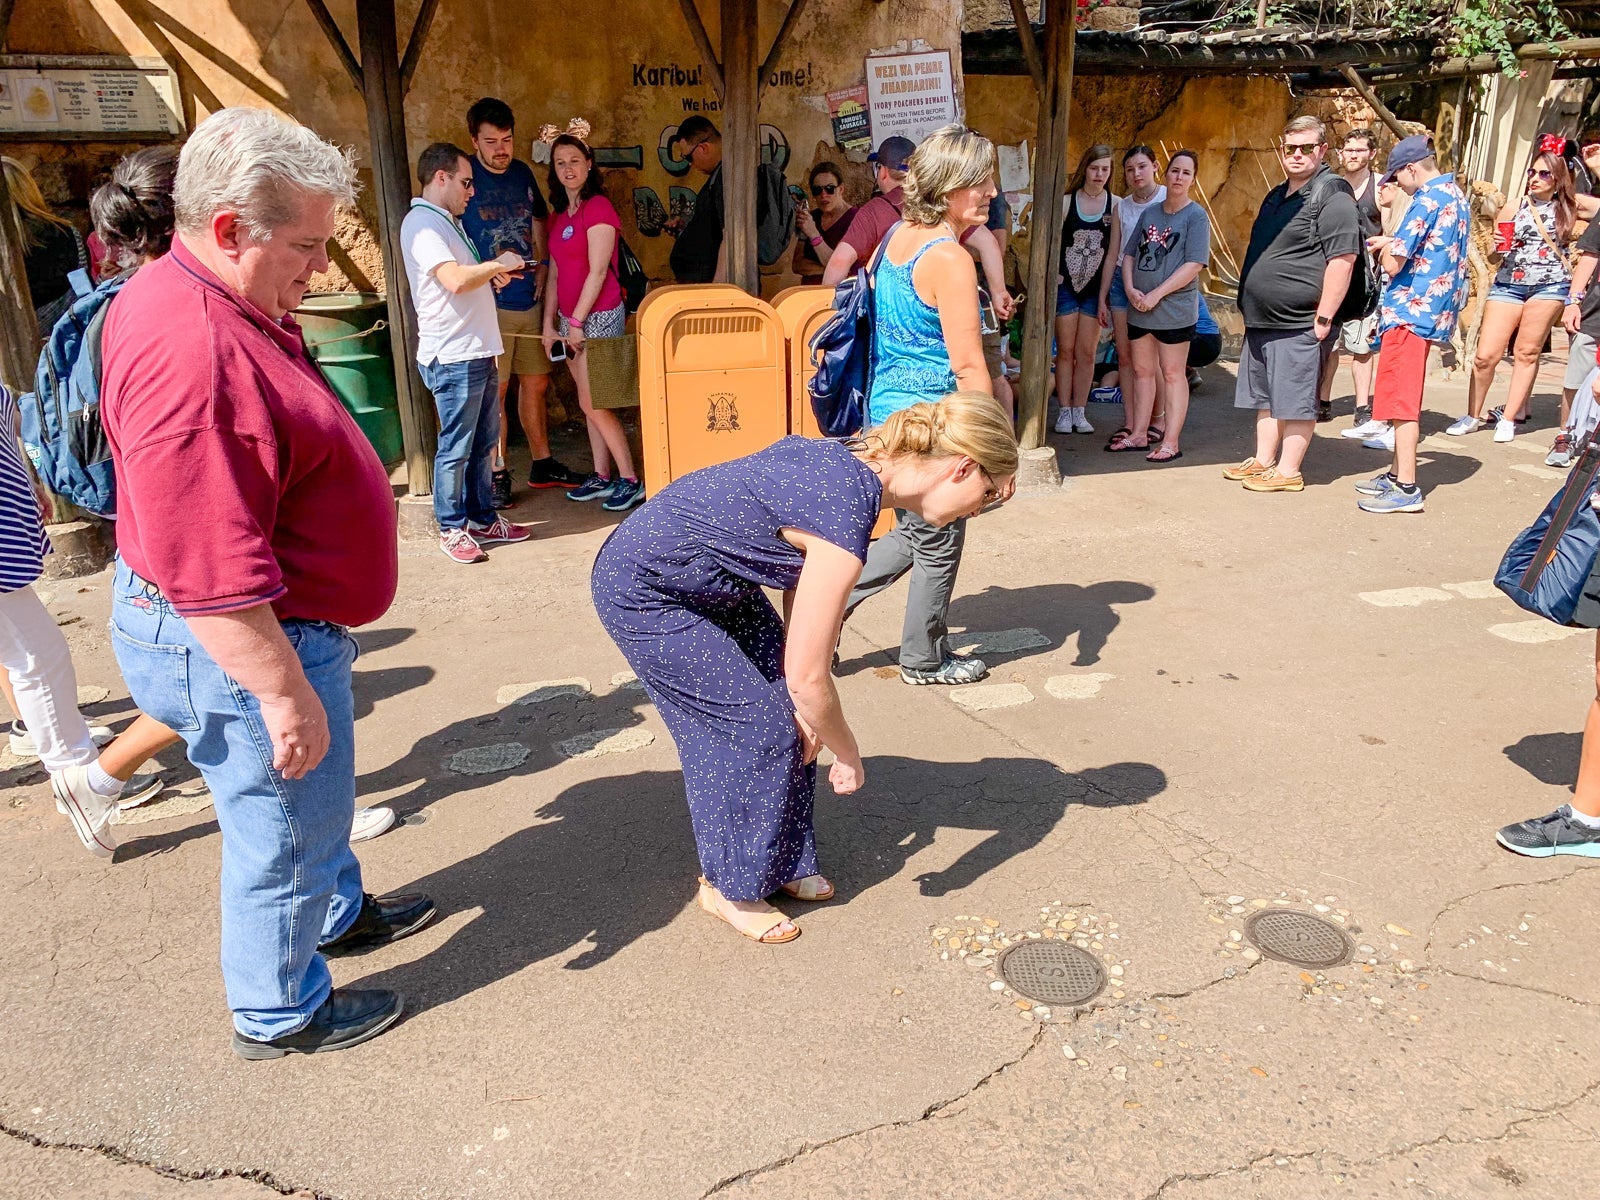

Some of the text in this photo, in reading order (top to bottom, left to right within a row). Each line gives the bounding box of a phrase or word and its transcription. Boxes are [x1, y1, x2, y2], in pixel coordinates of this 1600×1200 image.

[633, 62, 812, 87] Karibu! ome!
[874, 61, 943, 78] WEZI WA PEMBE
[682, 98, 722, 111] We hav
[874, 100, 892, 110] IVORY
[893, 98, 924, 109] POACHERS
[839, 119, 867, 130] SAUSAGES
[841, 114, 863, 124] FAMOUS
